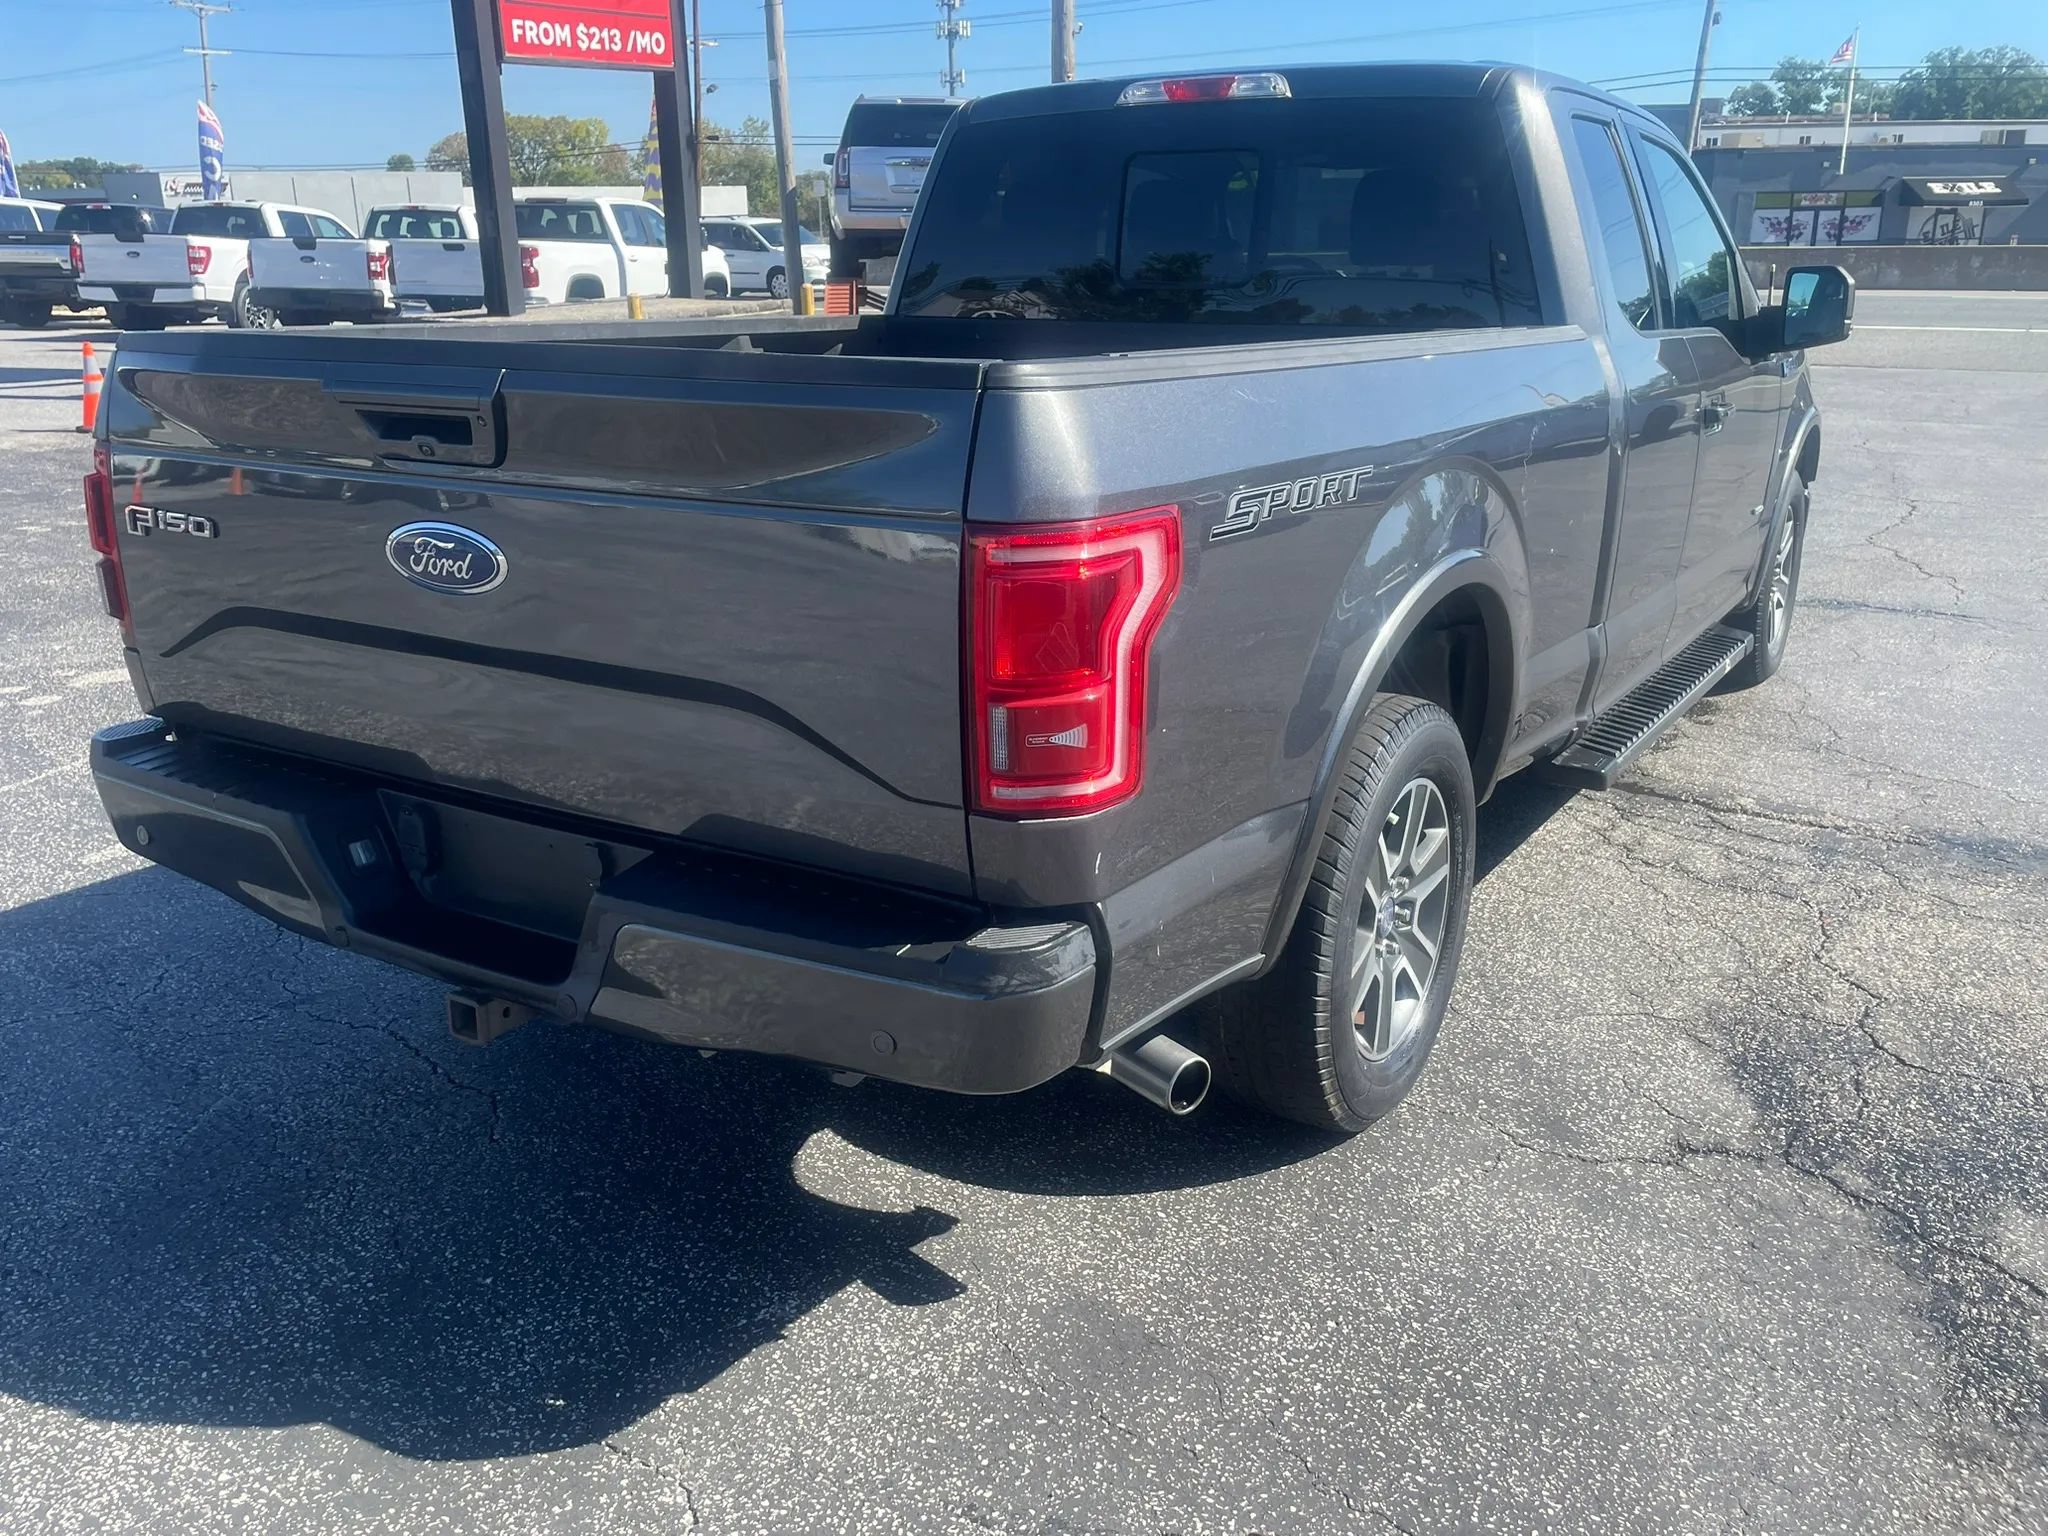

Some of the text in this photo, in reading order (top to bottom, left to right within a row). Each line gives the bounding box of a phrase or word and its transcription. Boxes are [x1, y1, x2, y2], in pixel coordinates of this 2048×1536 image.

[511, 18, 666, 55] FROM $213 /MO
[1209, 465, 1374, 541] SPORT
[410, 537, 473, 579] Ford
